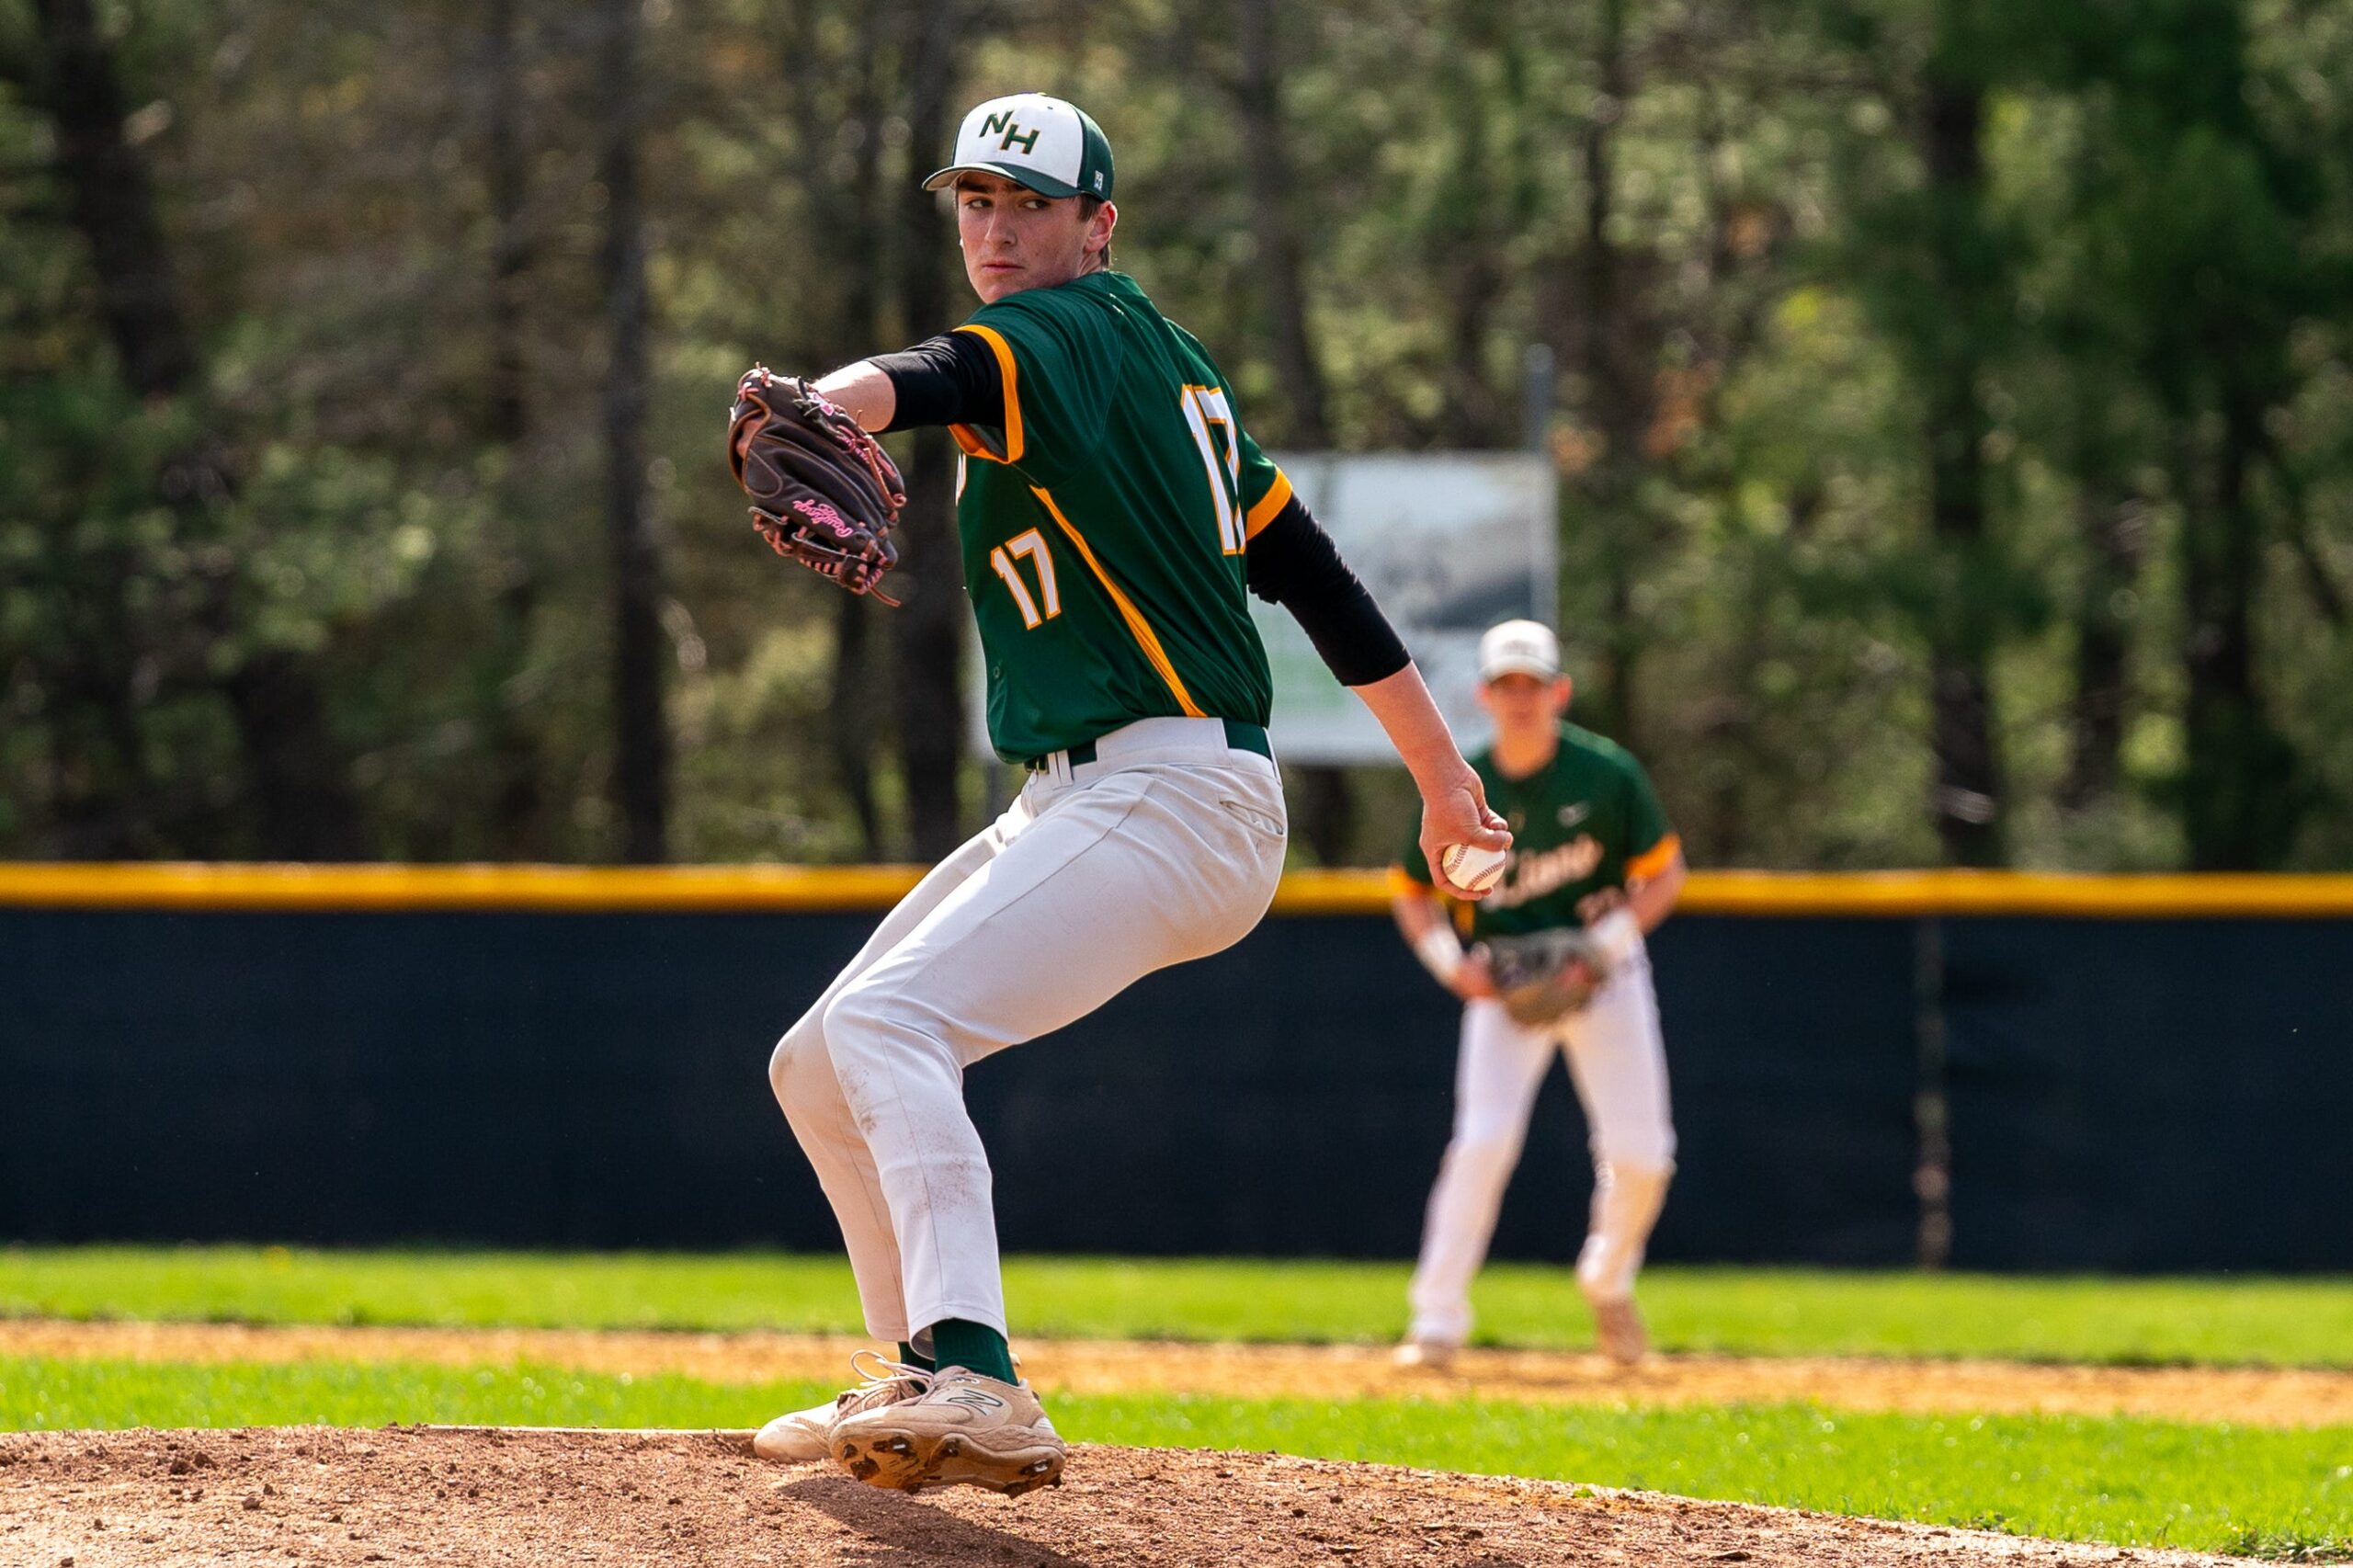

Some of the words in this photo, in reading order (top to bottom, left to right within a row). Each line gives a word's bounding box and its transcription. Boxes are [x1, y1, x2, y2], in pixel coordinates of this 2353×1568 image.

[978, 109, 1041, 155] NH
[792, 499, 854, 538] Rawlings
[990, 527, 1062, 631] 17
